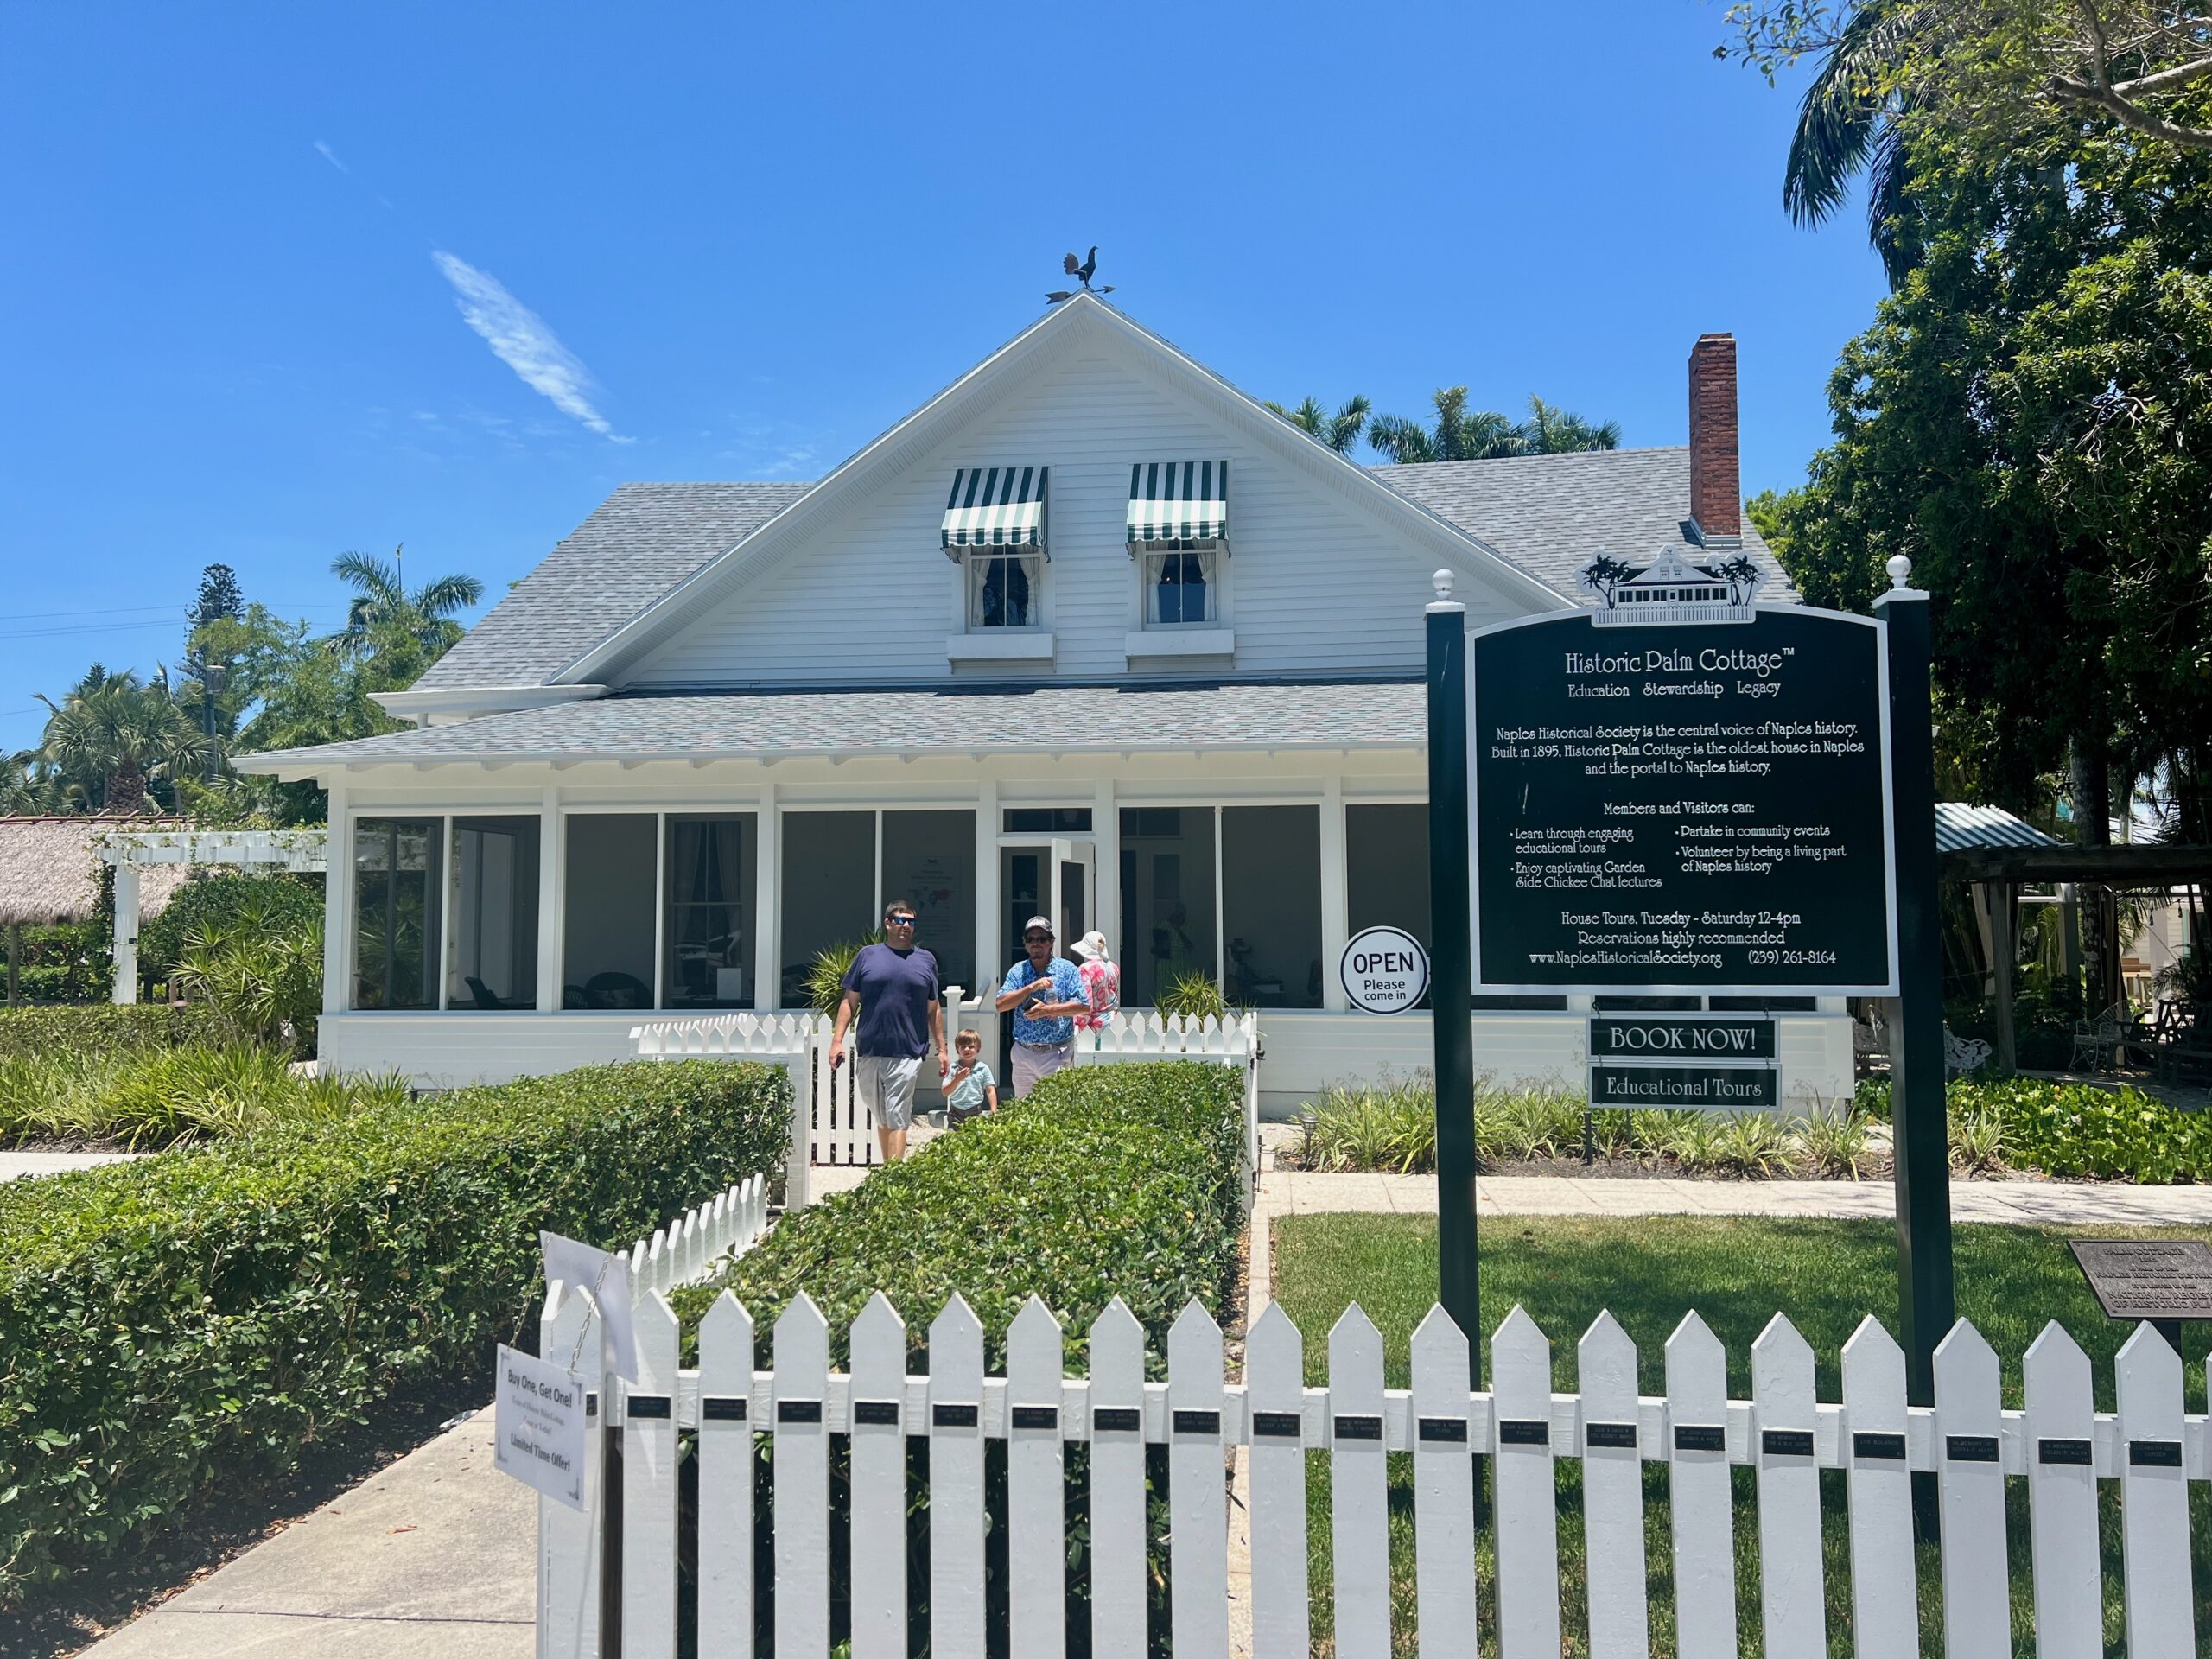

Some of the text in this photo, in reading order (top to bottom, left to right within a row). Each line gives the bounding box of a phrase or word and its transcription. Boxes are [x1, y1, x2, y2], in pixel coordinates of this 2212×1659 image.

[1566, 652, 1642, 673] Historic
[1645, 648, 1693, 671] Palm
[1568, 681, 1781, 698] Education Stewardship Legacy
[1497, 721, 1858, 744] Naples Historical Society is the central voice of Naples history.
[1491, 746, 1518, 758] Built
[1521, 746, 1529, 757] in
[1565, 745, 1610, 757] Historic
[1612, 743, 1640, 756] Palm
[1643, 742, 1691, 759] Cottage
[1694, 742, 1704, 754] is
[1707, 741, 1726, 754] the
[1729, 741, 1769, 754] oldest
[1771, 741, 1808, 753] house
[1810, 741, 1821, 753] in
[1823, 740, 1864, 756] Naples
[1586, 760, 1771, 778] and the portal to Naples history.
[1604, 801, 1754, 816] Members and Visitors can:
[1516, 827, 1634, 842] Learn through engaging
[1681, 825, 1830, 839] Partake in community events
[1516, 842, 1606, 853] educational tours
[1681, 844, 1847, 861] Volunteer by being a living part
[1516, 861, 1645, 876] Enjoy captivating Garden
[1681, 860, 1772, 875] of Naples history
[1516, 876, 1662, 887] Side Chickee Chat lectures
[1561, 912, 1599, 925] House
[1641, 911, 1690, 928] Tuesday
[1701, 911, 1756, 928] Saturday
[1758, 912, 1801, 928] 12-4pm
[1578, 931, 1785, 948] Reservations highly recommended
[1353, 952, 1414, 974] OPEN
[1529, 950, 1836, 968] www.NaplesHistoricalSociety.org (239) 261-8164
[1364, 980, 1405, 990] Please
[1364, 990, 1406, 1001] come in
[1610, 1027, 1756, 1050] BOOK NOW!
[1606, 1076, 1762, 1096] Educational Tours
[508, 1369, 519, 1389] Buy
[521, 1375, 537, 1396] One,
[539, 1382, 552, 1400] Get
[554, 1389, 572, 1408] One!
[511, 1433, 570, 1471] Limited Time Offer!
